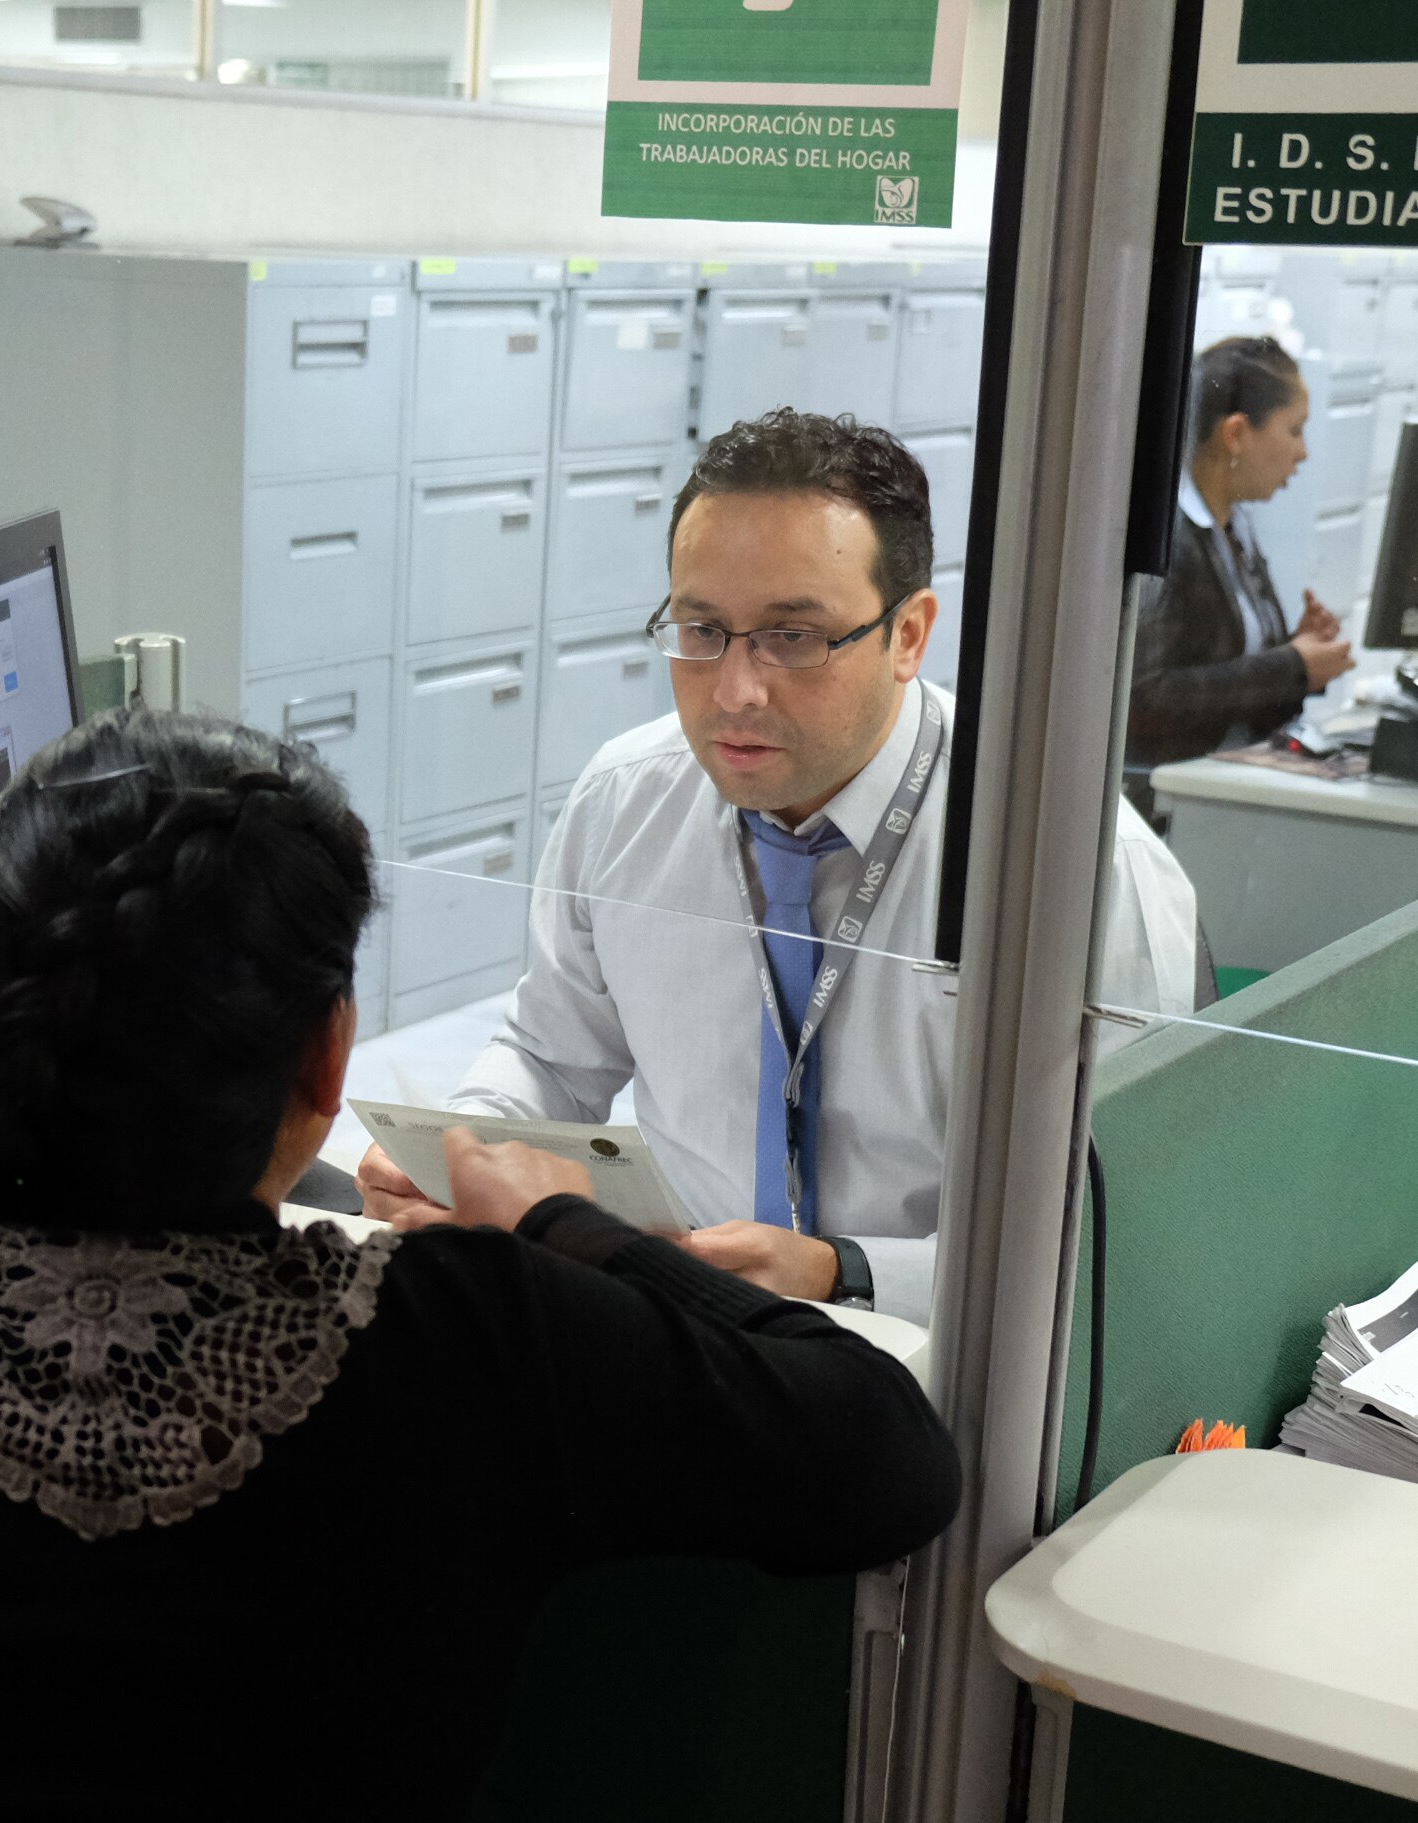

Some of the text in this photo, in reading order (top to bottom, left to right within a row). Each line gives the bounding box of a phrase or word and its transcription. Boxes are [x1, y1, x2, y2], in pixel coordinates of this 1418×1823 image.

[657, 112, 896, 138] INCORPORACIÓN DE LAS
[639, 143, 912, 171] TRABAJADORAS DEL HOGAR
[1279, 133, 1323, 169] D.
[1346, 134, 1389, 171] S.
[875, 209, 914, 223] IMSS
[907, 751, 932, 794] IMSS
[856, 860, 886, 904] IMSS
[759, 968, 773, 1009] IMSS
[813, 966, 838, 1008] IMSS
